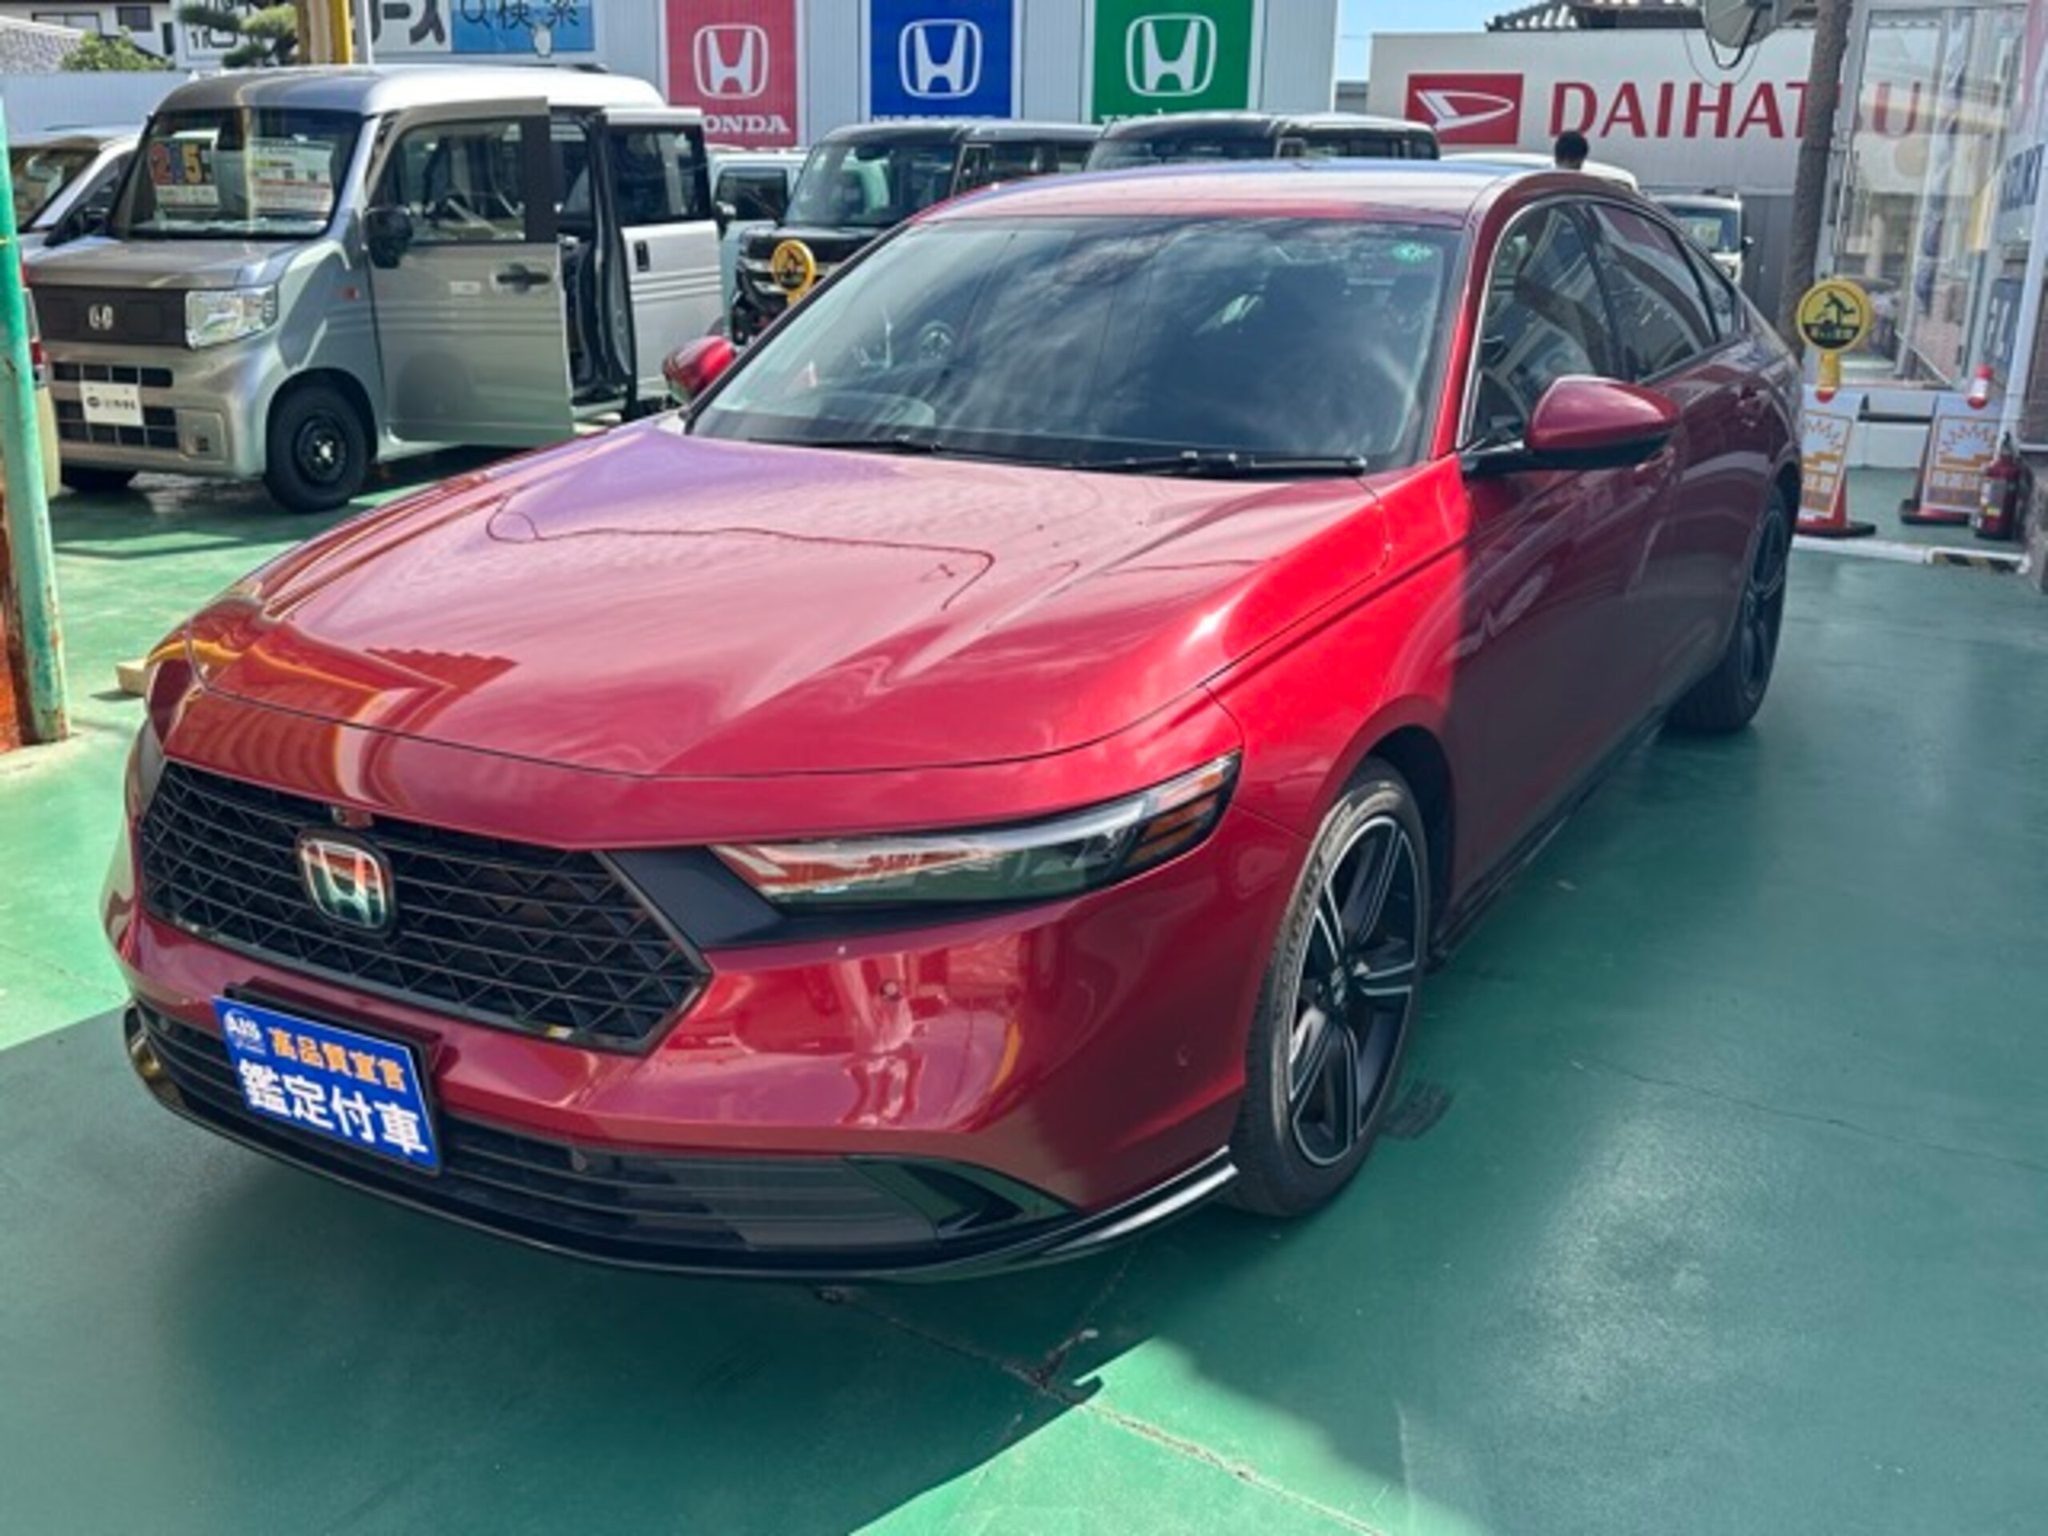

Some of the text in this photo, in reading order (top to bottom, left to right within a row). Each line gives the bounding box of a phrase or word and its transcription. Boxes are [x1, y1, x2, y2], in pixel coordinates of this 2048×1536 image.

[702, 114, 790, 134] ONDA
[1548, 82, 1922, 138] DAIHATU
[239, 1058, 429, 1156] 鑑定付車
